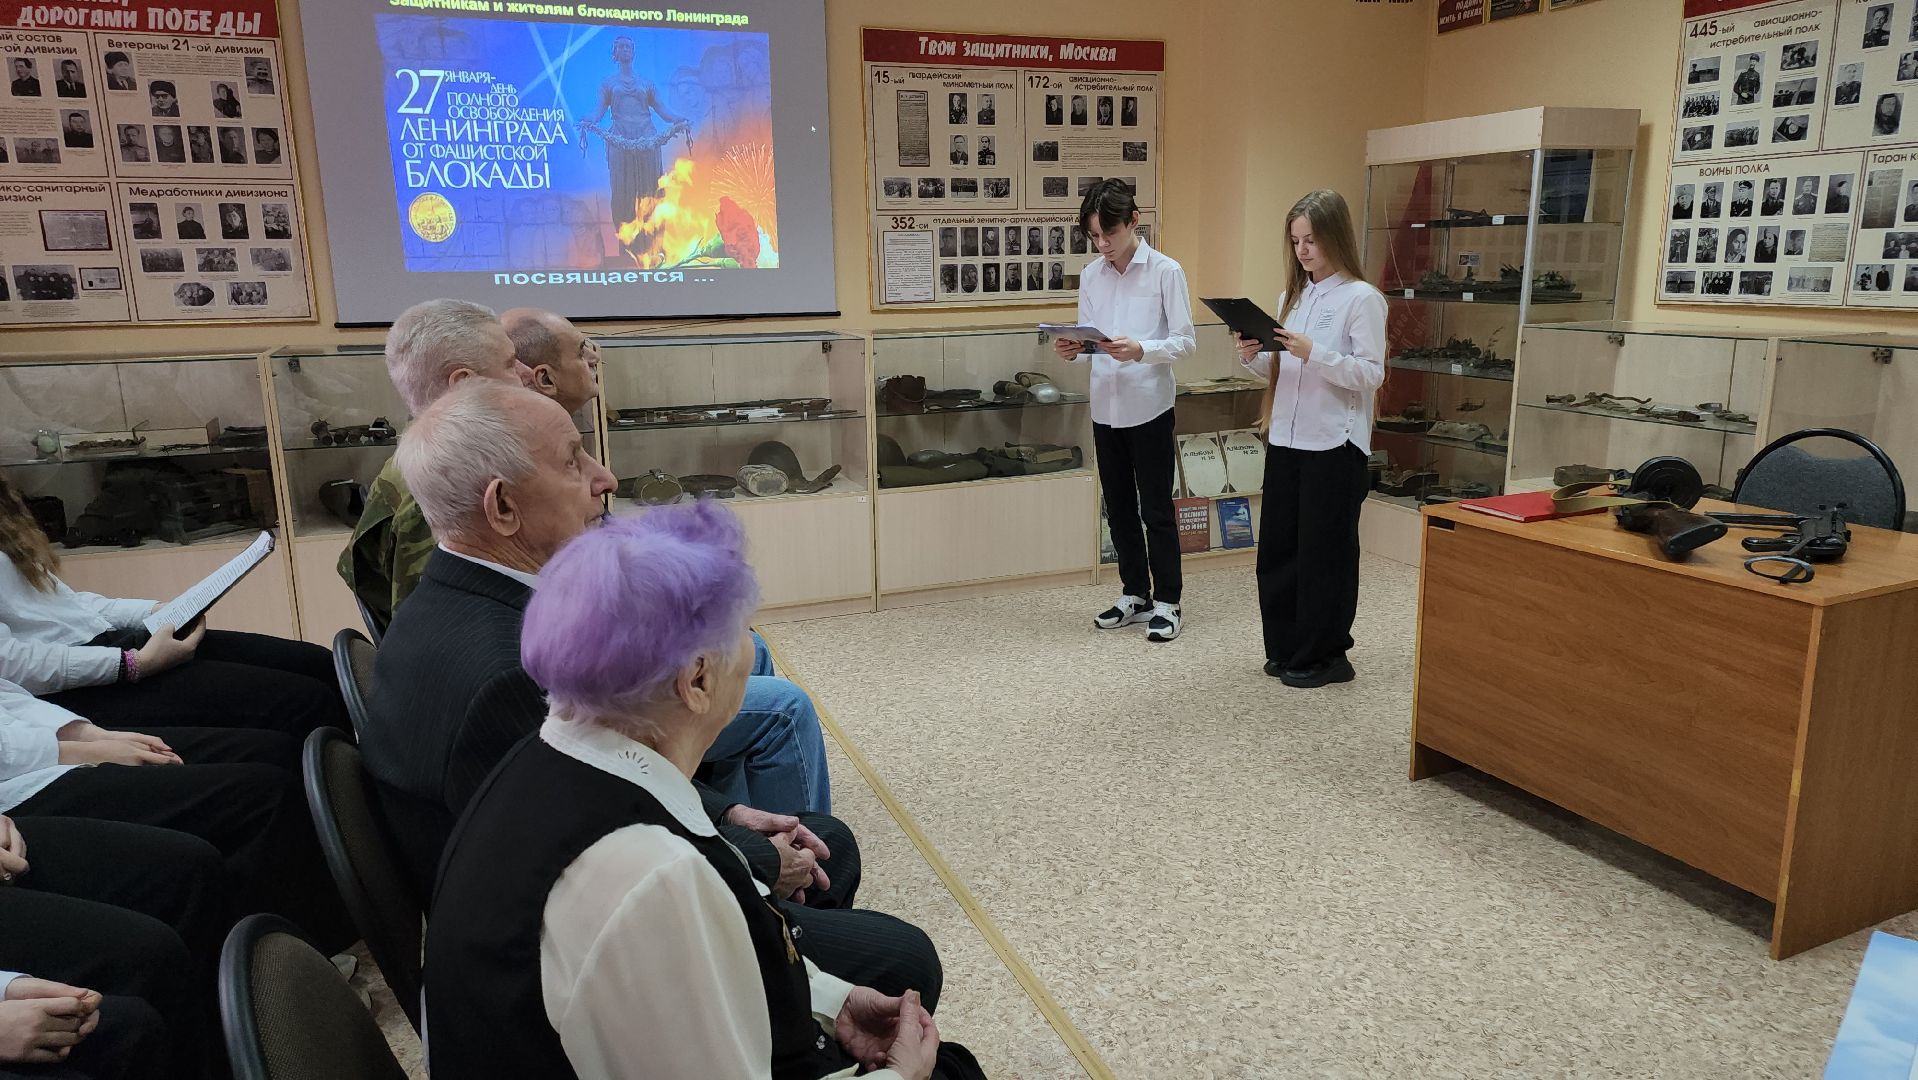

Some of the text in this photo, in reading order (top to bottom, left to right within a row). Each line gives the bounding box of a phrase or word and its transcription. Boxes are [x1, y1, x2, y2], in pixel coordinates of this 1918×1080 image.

[16, 5, 262, 36] ДОРОГАМИ ПОБЕДЫ
[389, 0, 749, 26] Защитникам и жителям блокадного Ленинграда
[1689, 10, 1823, 39] 445-ый авиационно-
[16, 34, 62, 43] состав
[1709, 23, 1821, 49] истребительный полк
[24, 45, 77, 55] дивизии
[107, 39, 264, 55] Ветераны 21-ой дивизии
[874, 70, 962, 84] 15-ый гвардейский
[943, 81, 994, 89] минометный
[1027, 75, 1063, 90] 172-ой
[396, 69, 444, 115] 27
[490, 82, 517, 94] ДЕНЬ
[1074, 83, 1135, 92] истребительный
[447, 92, 518, 108] ПОЛНОГО
[448, 105, 565, 122] ОСВОБОЖДЕНИЯ
[400, 118, 568, 144] ЛЕНИНГРАДА
[402, 142, 548, 161] ОТ ФАШИСТСКОЙ
[1873, 153, 1907, 164] Таран
[405, 160, 551, 190] БЛОКАДЫ
[1699, 164, 1770, 177] ВОИНЫ ПОЛКА
[129, 187, 289, 199] Медработники дивизиона
[933, 217, 975, 225] отдельный
[495, 269, 685, 287] посвящается
